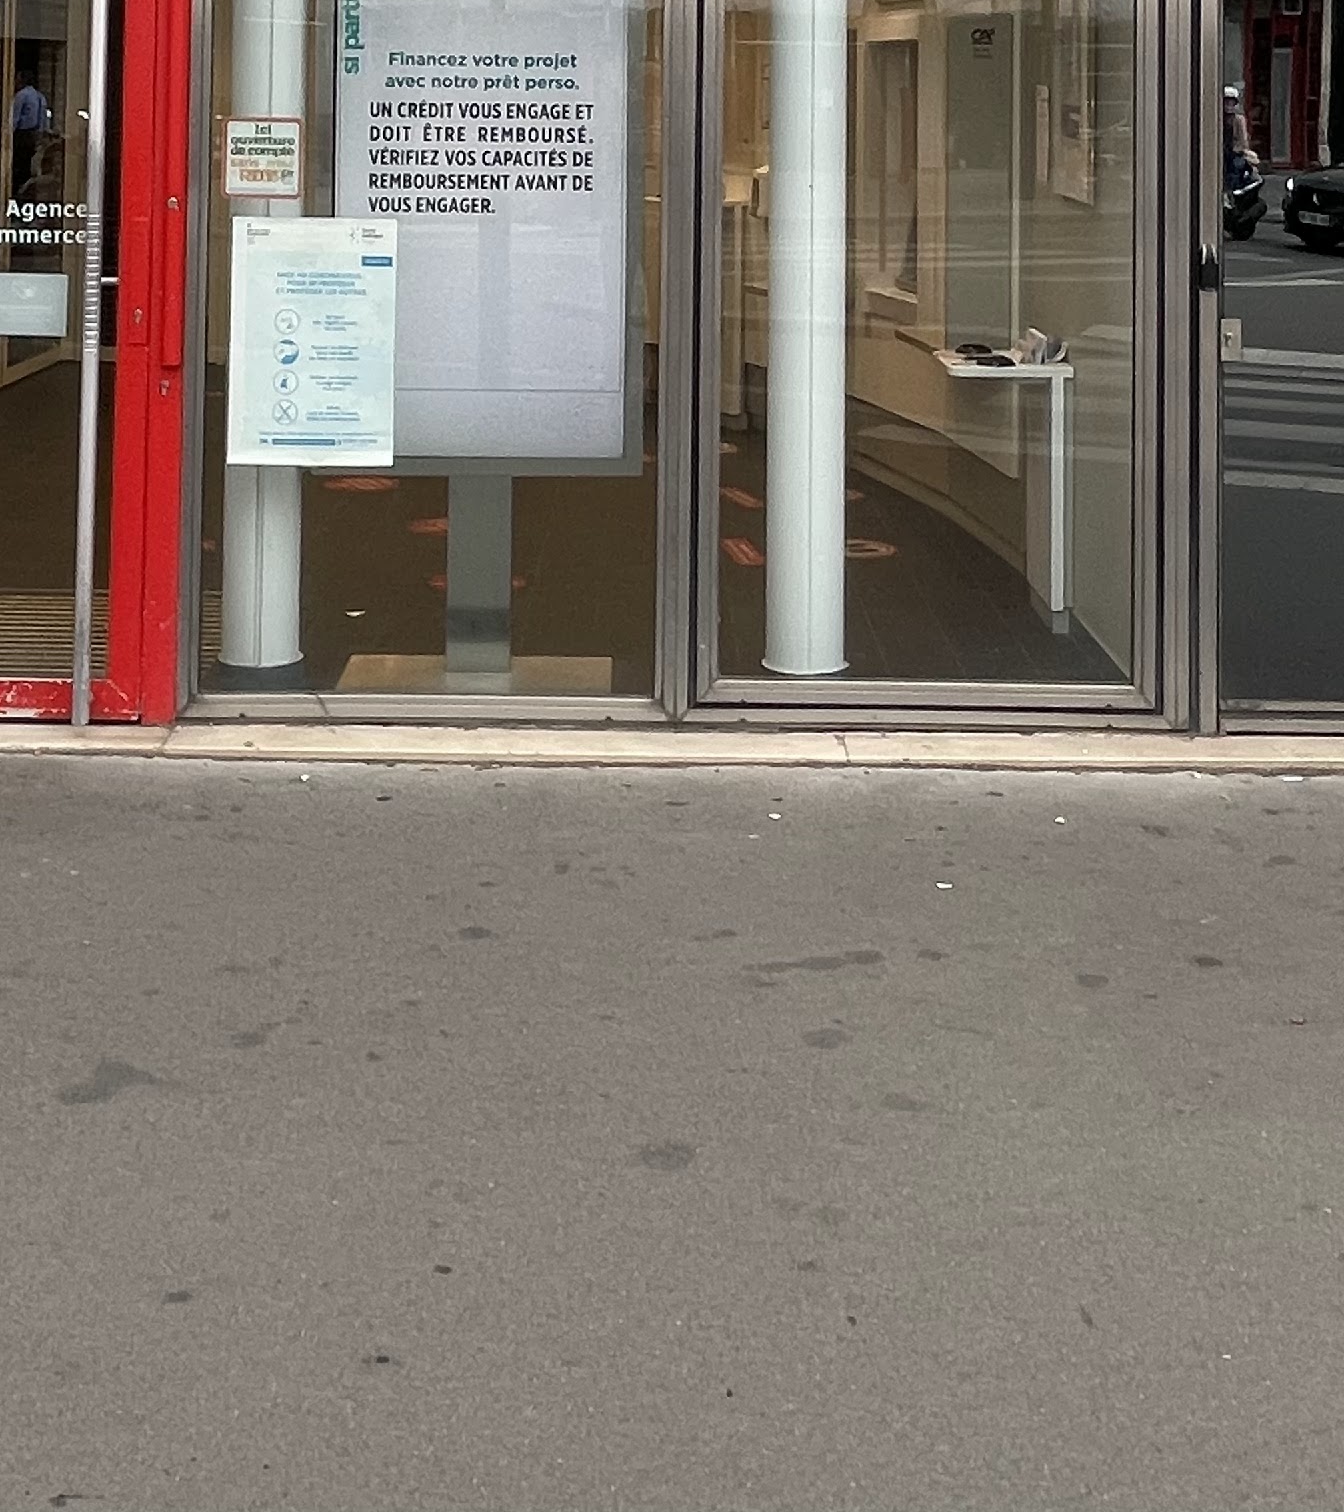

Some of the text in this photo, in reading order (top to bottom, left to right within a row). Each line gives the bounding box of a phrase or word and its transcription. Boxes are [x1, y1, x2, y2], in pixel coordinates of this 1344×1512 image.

[388, 51, 577, 71] Financez votre projet
[385, 74, 580, 91] avec notre prêt perso.
[370, 99, 594, 120] UN CRÉDIT VOUS ENGAGE ET
[369, 122, 594, 144] DOIT ÊTRE REMBOURSÉ.
[368, 146, 594, 168] VÉRIFIEZ VOS CAPACITÉS DE
[368, 173, 594, 191] REMBOURSEMENT AVANT DE
[6, 199, 88, 222] Agence
[368, 197, 496, 214] VOUS ENGAGER.
